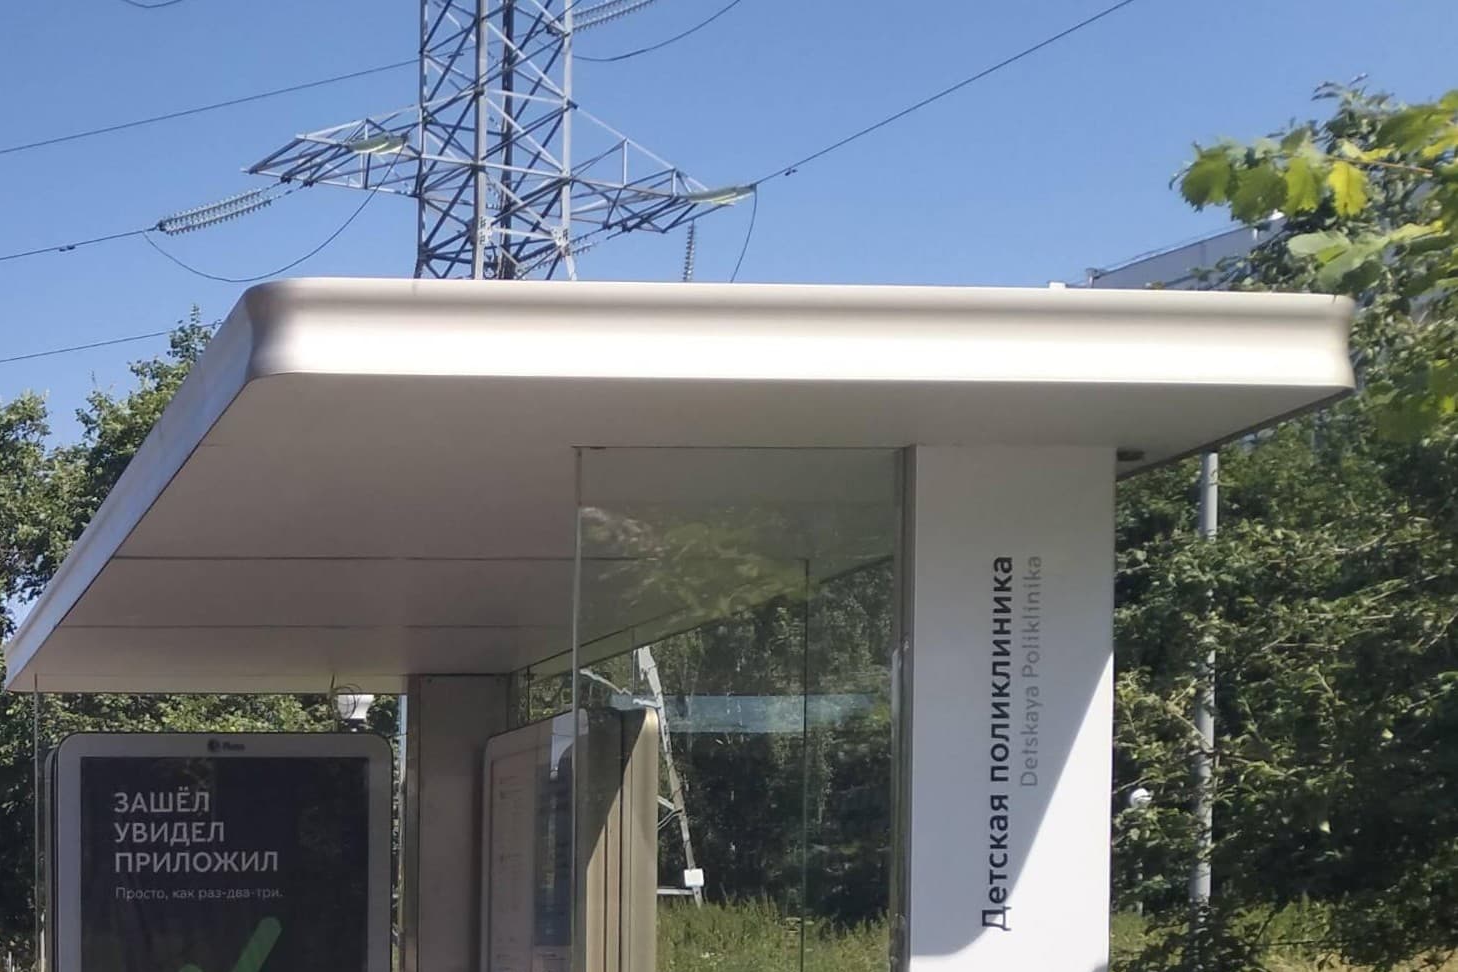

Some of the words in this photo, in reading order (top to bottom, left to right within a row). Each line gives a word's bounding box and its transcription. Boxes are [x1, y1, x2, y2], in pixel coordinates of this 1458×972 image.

[1022, 555, 1043, 678] Poliklinika
[990, 555, 1014, 783] поликлиника
[1020, 685, 1043, 788] Detskaya
[114, 786, 210, 813] ЗАШЁЛ
[114, 822, 225, 847] УВИДЕЛ
[115, 851, 279, 873] ПРИЛОЖИЛ
[981, 793, 1012, 932] Детская
[115, 887, 169, 901] Просто,
[172, 889, 194, 898] как
